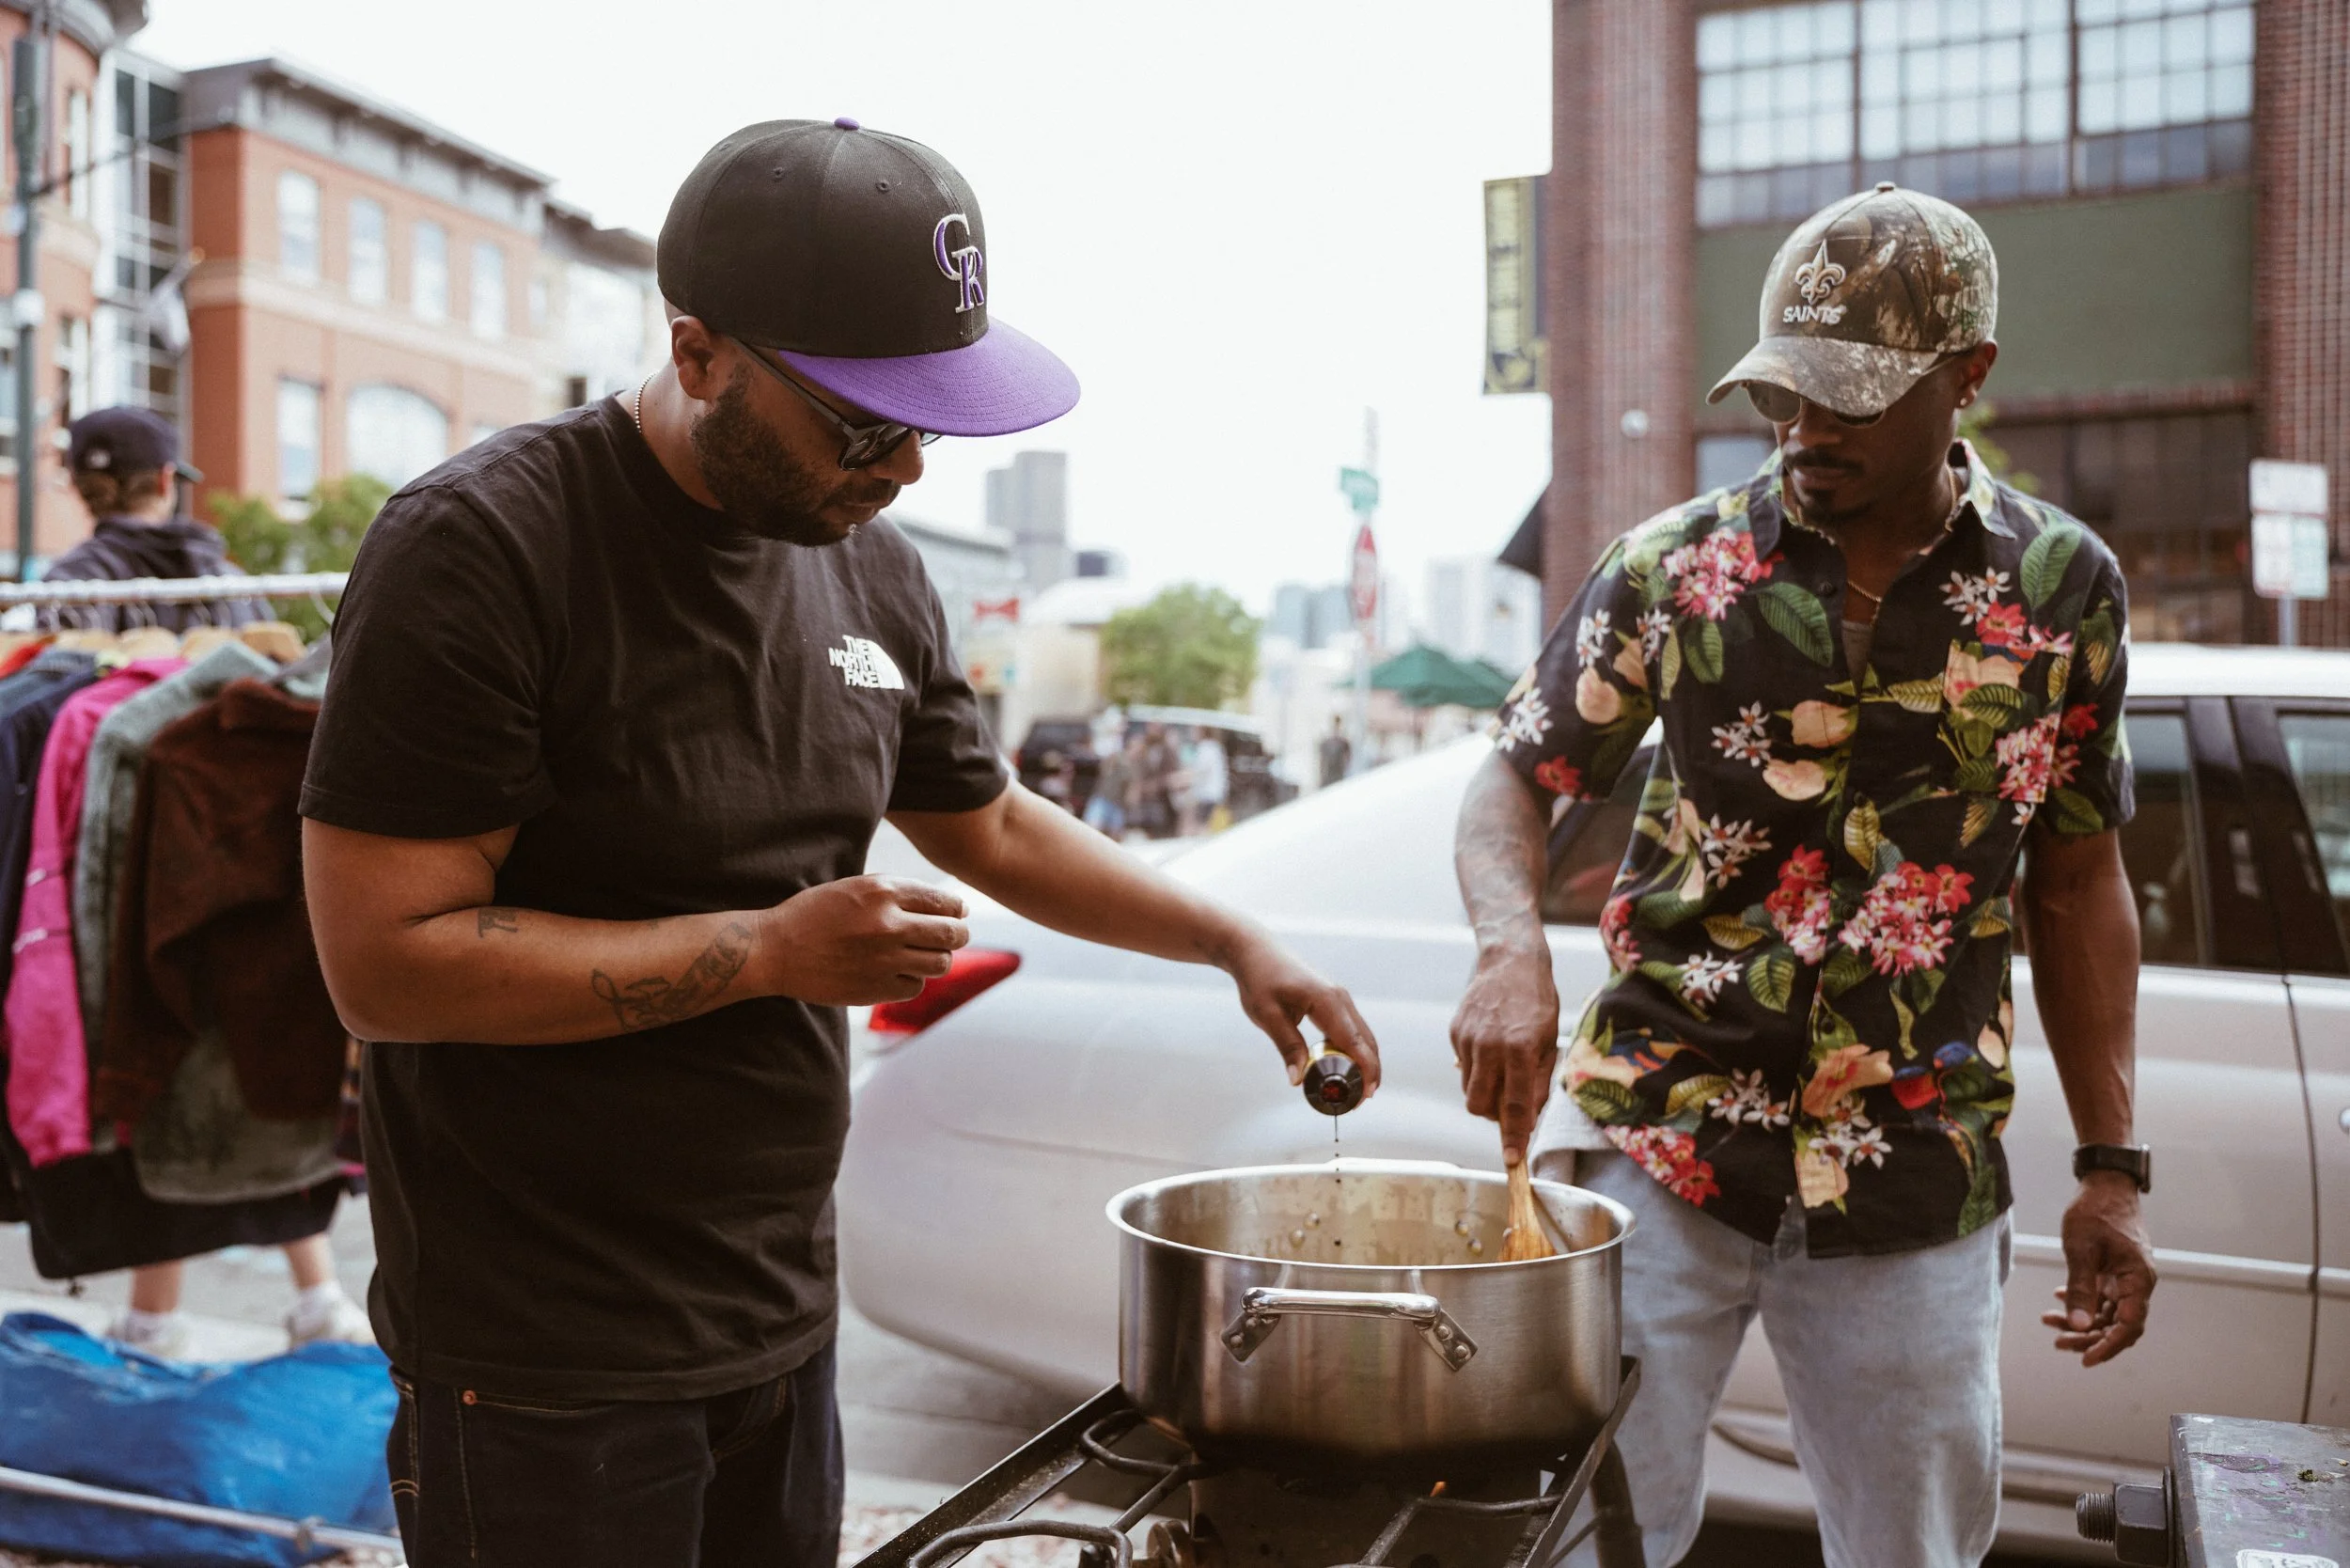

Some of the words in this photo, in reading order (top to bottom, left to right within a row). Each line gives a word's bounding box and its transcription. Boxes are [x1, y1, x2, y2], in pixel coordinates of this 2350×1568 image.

[932, 212, 985, 314] CR
[1782, 304, 1842, 325] SAINTS
[842, 635, 870, 655] THE
[828, 647, 875, 671] NORTH
[844, 667, 881, 688] FACE
